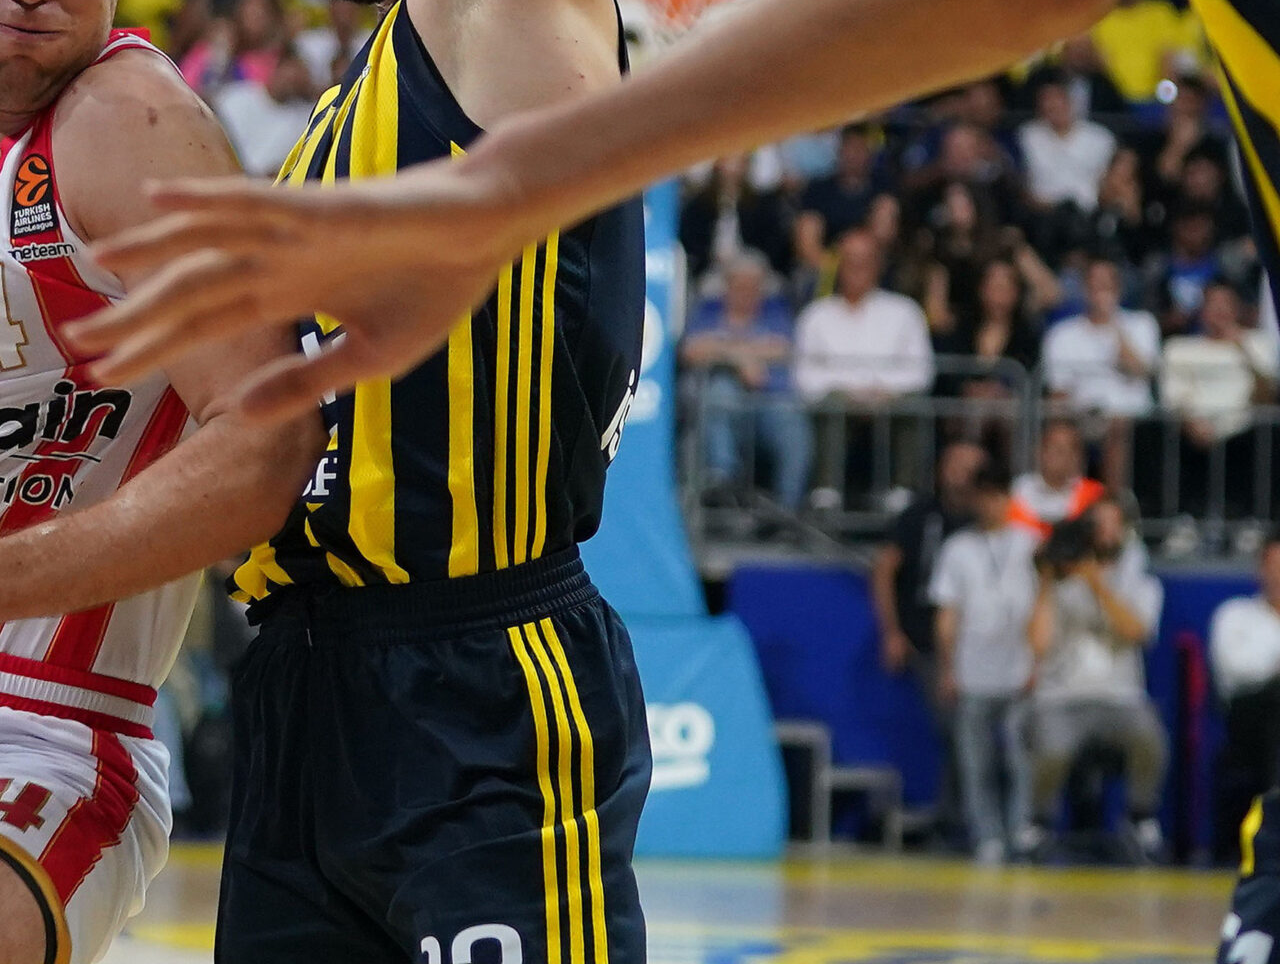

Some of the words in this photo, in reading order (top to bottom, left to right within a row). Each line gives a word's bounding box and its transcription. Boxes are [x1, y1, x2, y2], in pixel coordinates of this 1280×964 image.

[14, 202, 51, 219] TURKISH
[14, 211, 53, 228] AIRLINES
[14, 221, 54, 235] EuroLeague
[8, 243, 75, 260] neteam
